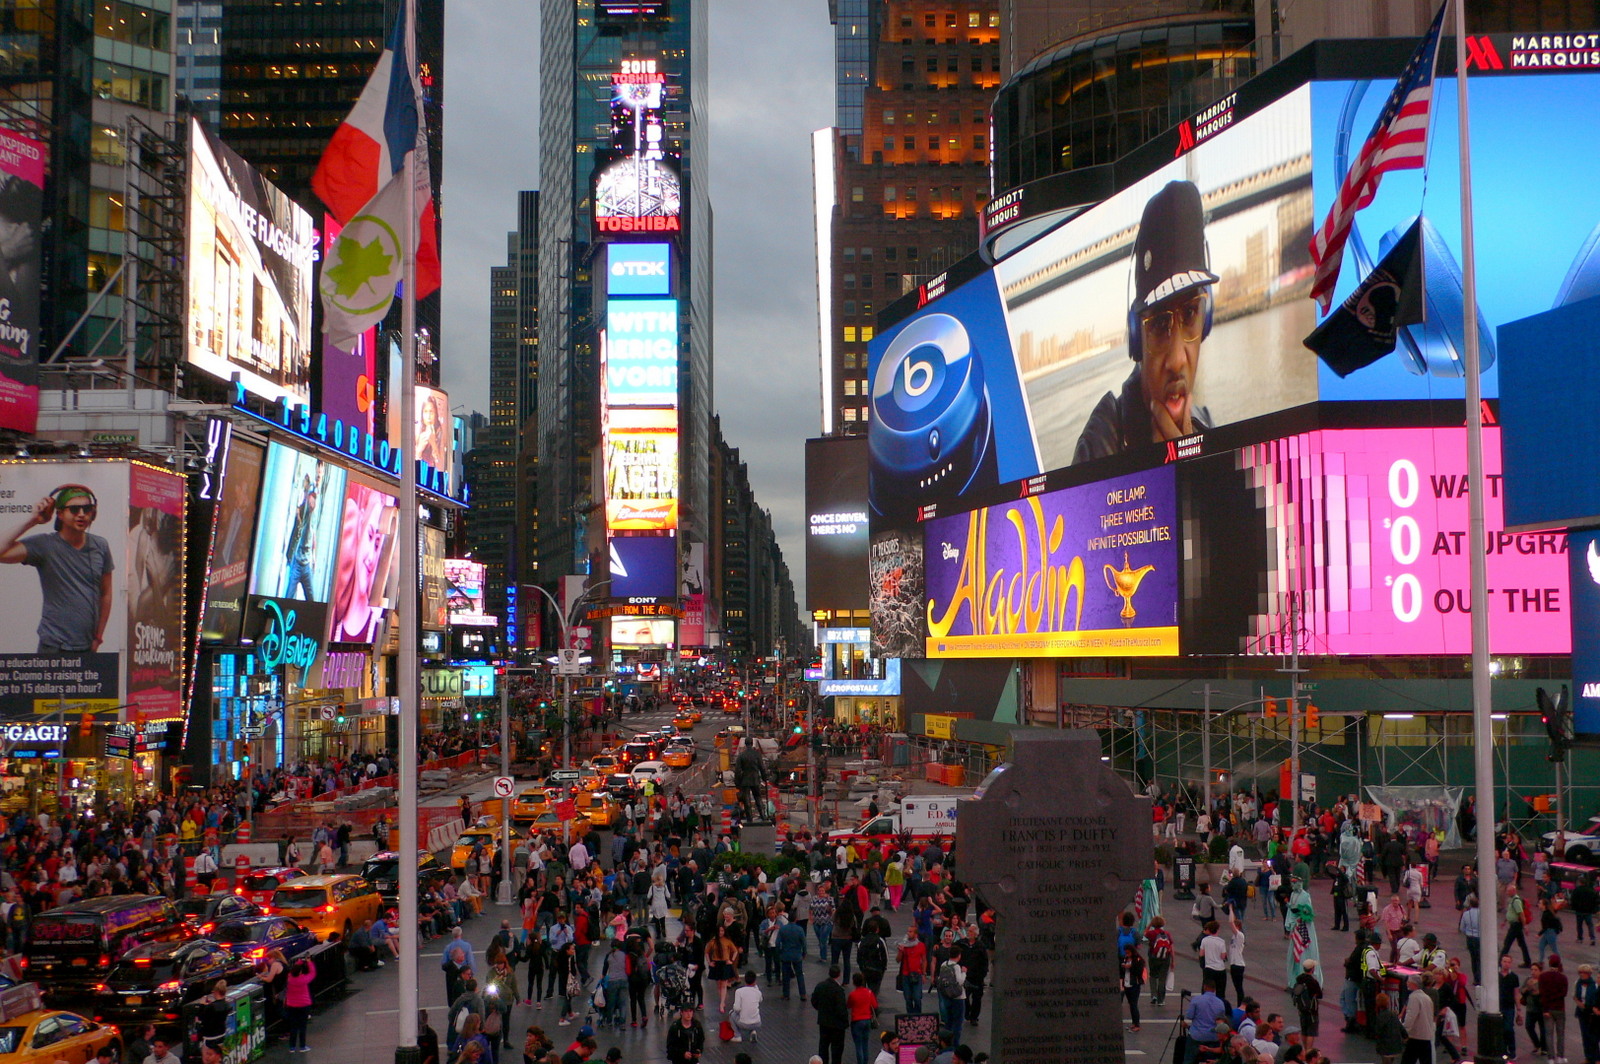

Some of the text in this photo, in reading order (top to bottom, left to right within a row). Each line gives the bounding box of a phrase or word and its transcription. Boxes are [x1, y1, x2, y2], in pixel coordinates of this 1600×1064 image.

[612, 73, 664, 84] TOSHIBA
[1196, 93, 1238, 127] MARRIOTT
[1196, 110, 1232, 141] MARQUIS
[987, 188, 1024, 215] MARRIOTT
[596, 216, 679, 231] TOSHIBA
[987, 206, 1019, 229] MARQUIS
[624, 261, 665, 276] TDK
[927, 272, 948, 290] MARRIOTT
[927, 284, 945, 301] MARQUIS
[608, 312, 676, 332] WITH
[1388, 459, 1503, 508] 0 WAT
[1106, 485, 1147, 506] ONE LAMP.
[810, 512, 868, 524] ONCE DRIVEN,
[1099, 506, 1156, 529] THREE WISHES.
[810, 525, 857, 535] THERE'S NO
[1087, 526, 1172, 552] INFINITE POSSIBILITIES.
[1383, 515, 1421, 565] $0
[1431, 531, 1466, 555] AT
[941, 542, 960, 563] Disney
[927, 494, 1085, 638] Aladdin
[1384, 573, 1422, 623] $0
[1502, 588, 1560, 613] THE
[622, 605, 640, 615] FROM
[641, 605, 656, 615] THE
[261, 600, 319, 689] Disney
[7, 657, 50, 668] education
[51, 659, 61, 668] or
[62, 657, 82, 668] hard
[13, 671, 43, 681] Cuomo
[45, 671, 52, 681] is
[53, 671, 83, 682] raising
[85, 670, 99, 681] the
[321, 653, 366, 690] FOREVER
[11, 683, 20, 694] to
[23, 684, 33, 694] 15
[35, 683, 64, 694] dollars
[66, 686, 77, 694] an
[78, 683, 102, 694] hour?
[825, 683, 879, 693] AÉROPOSTALE
[927, 810, 946, 819] F.D.
[1009, 815, 1109, 827] LIEUTENANT COLONEL
[1001, 829, 1056, 842] FRANCIS
[1072, 828, 1118, 841] DUFFY
[1017, 859, 1103, 870] CATHOLIC PRIEST
[1030, 935, 1047, 943] LIFE
[1067, 933, 1106, 942] SERVICE
[1015, 952, 1107, 962] GOD AND COUNTRY
